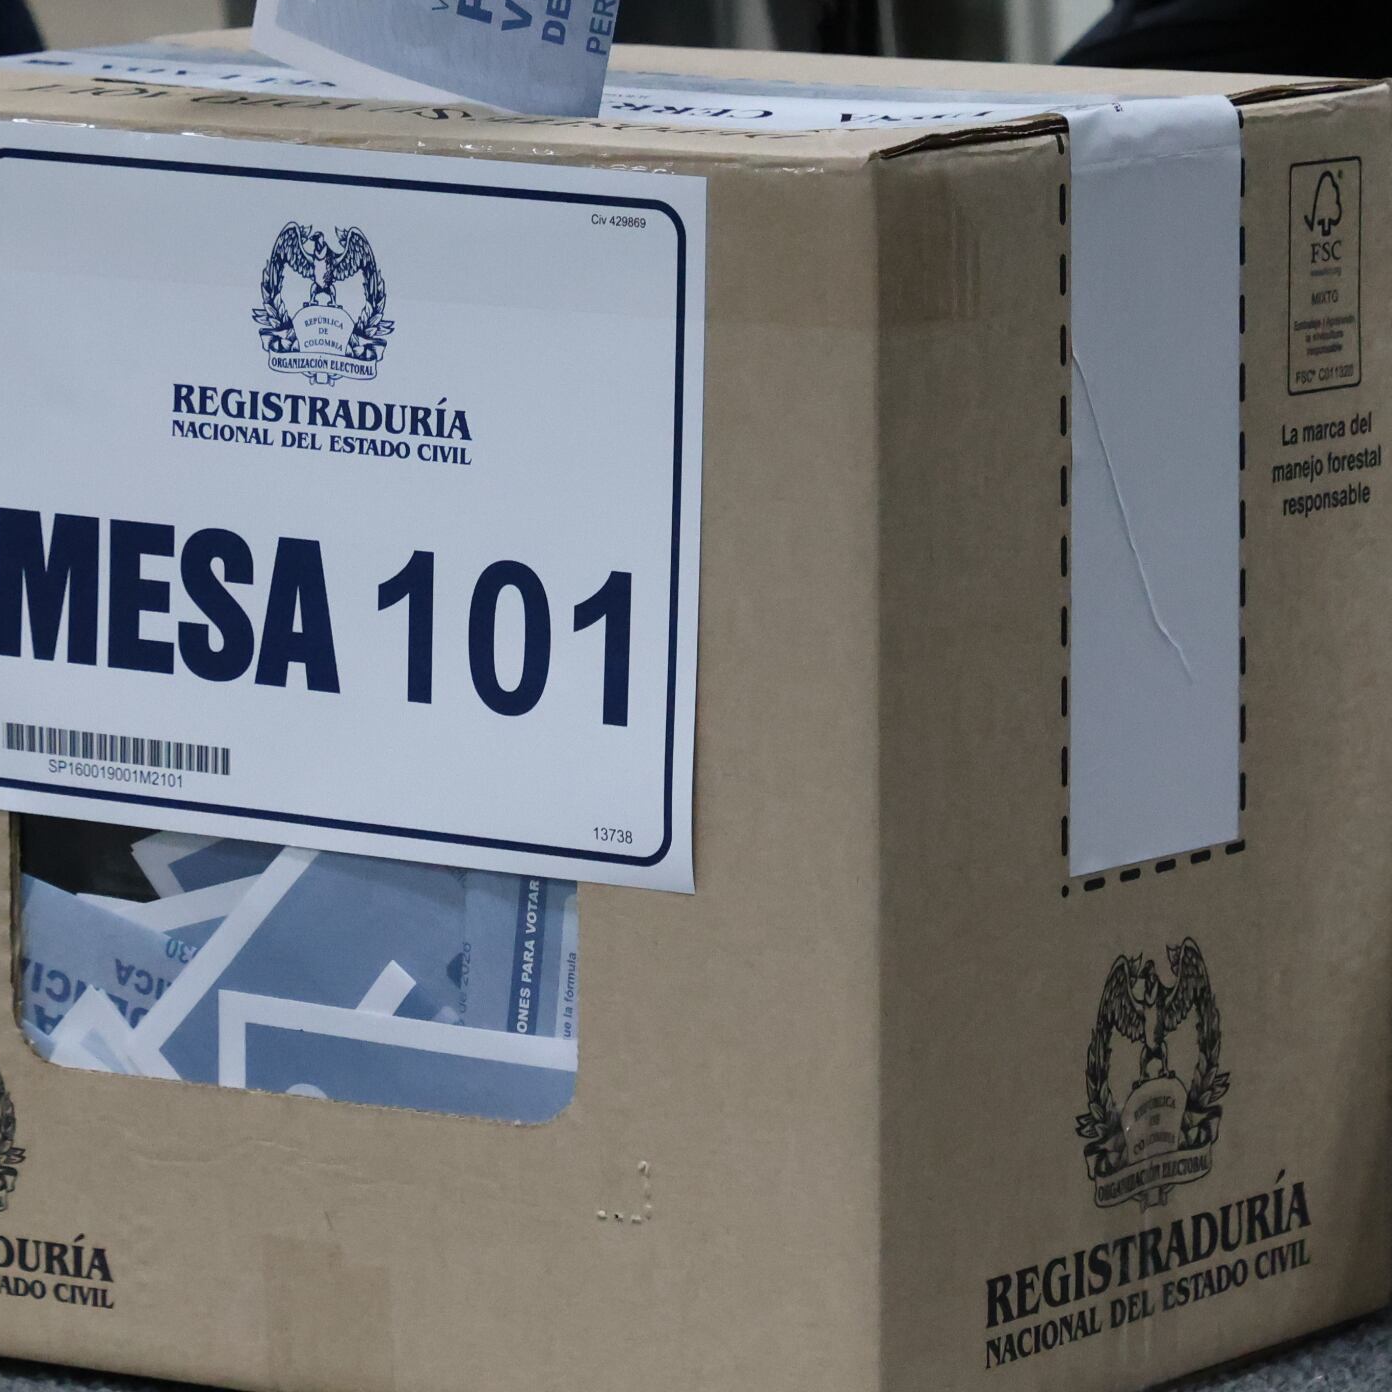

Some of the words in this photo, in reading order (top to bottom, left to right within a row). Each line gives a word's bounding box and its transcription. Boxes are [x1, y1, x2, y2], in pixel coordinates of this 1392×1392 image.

[591, 213, 607, 225] Civ
[609, 215, 647, 229] 429869
[1310, 240, 1342, 264] FSC
[303, 316, 344, 330] REPÚBLICA
[318, 327, 329, 336] DE
[303, 339, 343, 352] COLOMBIA
[271, 355, 328, 370] ORGANIZACIÓN
[330, 359, 374, 376] ELECTORAL
[172, 383, 473, 441] REGISTRADURÍA
[171, 419, 274, 446] NACIONAL
[281, 430, 322, 450] DEL
[329, 435, 410, 459] ESTADO
[417, 443, 473, 465] CIVIL
[1281, 424, 1298, 446] La
[1302, 416, 1346, 443] marca
[1350, 411, 1372, 435] del
[1272, 454, 1324, 484] manejo
[1326, 444, 1382, 474] forestal
[1282, 482, 1371, 518] responsable
[378, 550, 632, 727] 101
[48, 758, 183, 788] SP160019001M2101
[593, 827, 633, 845] 13738
[524, 879, 540, 935] VOTAR
[520, 939, 536, 983] PARA
[562, 1006, 573, 1018] la
[986, 1169, 1311, 1328] REGISTRADURÍA
[53, 1283, 115, 1309] CIVIL
[986, 1304, 1102, 1369] NACIONAL
[1110, 1289, 1155, 1329] DEL
[1162, 1258, 1248, 1312] ESTADO
[1255, 1238, 1311, 1280] CIVIL
